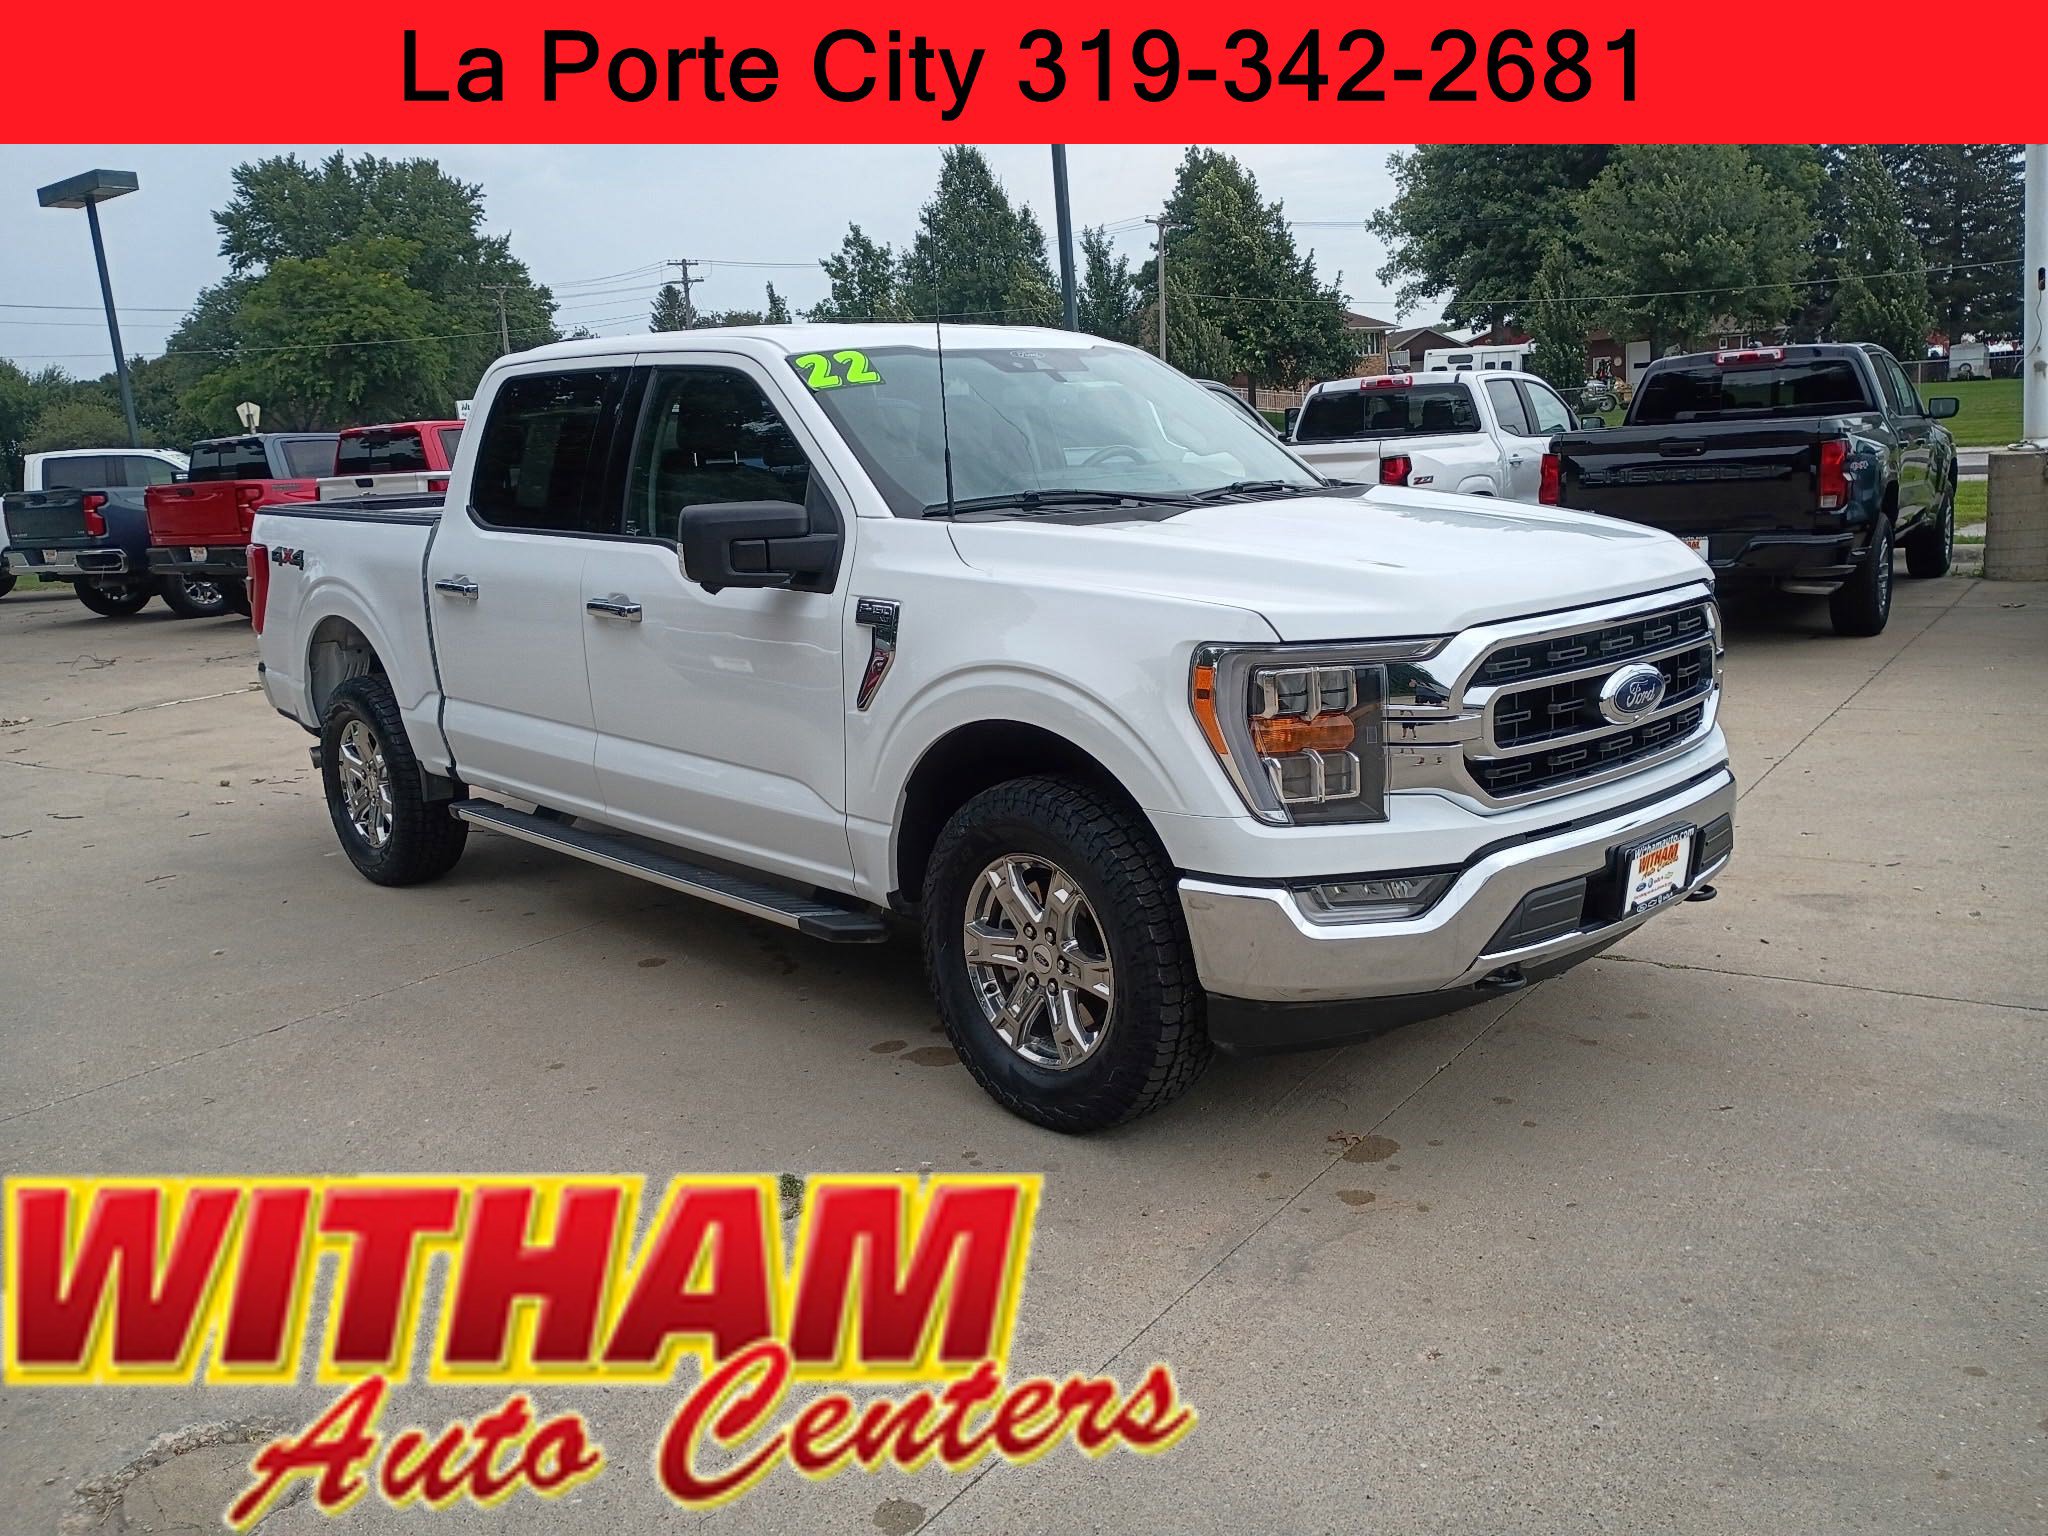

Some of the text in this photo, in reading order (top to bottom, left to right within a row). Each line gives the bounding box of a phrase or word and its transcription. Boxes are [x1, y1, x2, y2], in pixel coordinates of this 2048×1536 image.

[795, 350, 881, 391] 22
[1585, 464, 1780, 485] CHEVROLET
[1626, 679, 1657, 708] Ford
[1638, 842, 1679, 874] WITHAM
